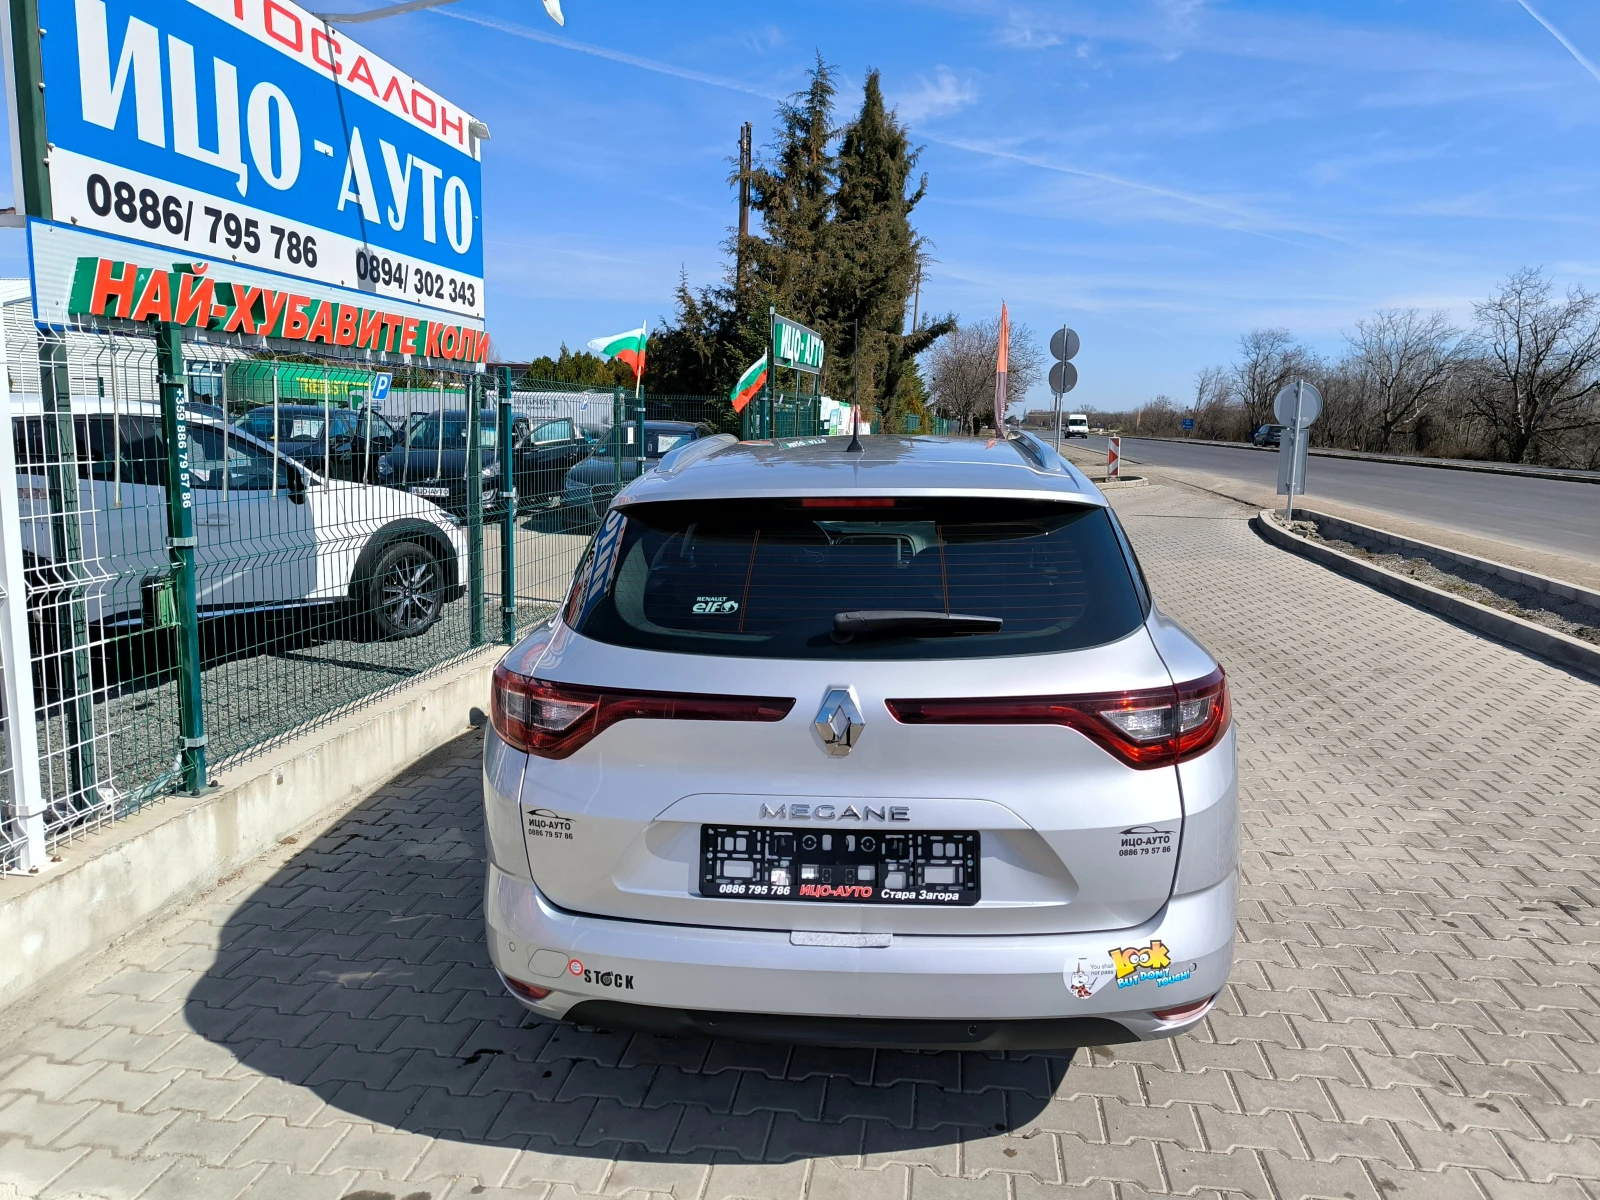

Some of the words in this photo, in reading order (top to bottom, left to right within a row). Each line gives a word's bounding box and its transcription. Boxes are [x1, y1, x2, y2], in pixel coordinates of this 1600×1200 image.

[87, 173, 193, 242] 0886/
[204, 205, 261, 254] 795
[270, 225, 318, 268] 786
[356, 251, 409, 293] 0894/
[414, 267, 444, 299] 302
[448, 277, 476, 307] 343
[89, 258, 421, 354] НАЙ-ХУБАВИТЕ
[425, 321, 490, 363] КОЛИ
[781, 323, 824, 368] ИЦО-АУТО
[375, 376, 388, 397] P
[176, 388, 185, 421] +359
[177, 424, 187, 449] 886
[179, 452, 189, 469] 79
[180, 472, 190, 488] 57
[182, 492, 192, 509] 86
[692, 601, 722, 613] elf
[760, 802, 911, 822] MEGANE
[528, 818, 571, 831] ИЦО-АУТО
[528, 828, 544, 837] 0886
[544, 830, 553, 838] 79
[554, 831, 563, 839] 57
[564, 832, 574, 840] 86
[1121, 835, 1170, 847] ИЦО-АУТО
[1118, 848, 1138, 857] 0886
[1139, 847, 1150, 856] 79
[1150, 846, 1161, 855] 57
[1161, 845, 1171, 854] 86
[719, 884, 746, 895] 0886
[748, 885, 769, 896] 795
[770, 885, 791, 896] 786
[799, 884, 873, 898] ИЦО-АУТО
[881, 888, 917, 900] Стара
[918, 889, 960, 902] Загора
[1100, 969, 1114, 977] pass
[1117, 975, 1139, 989] BUT
